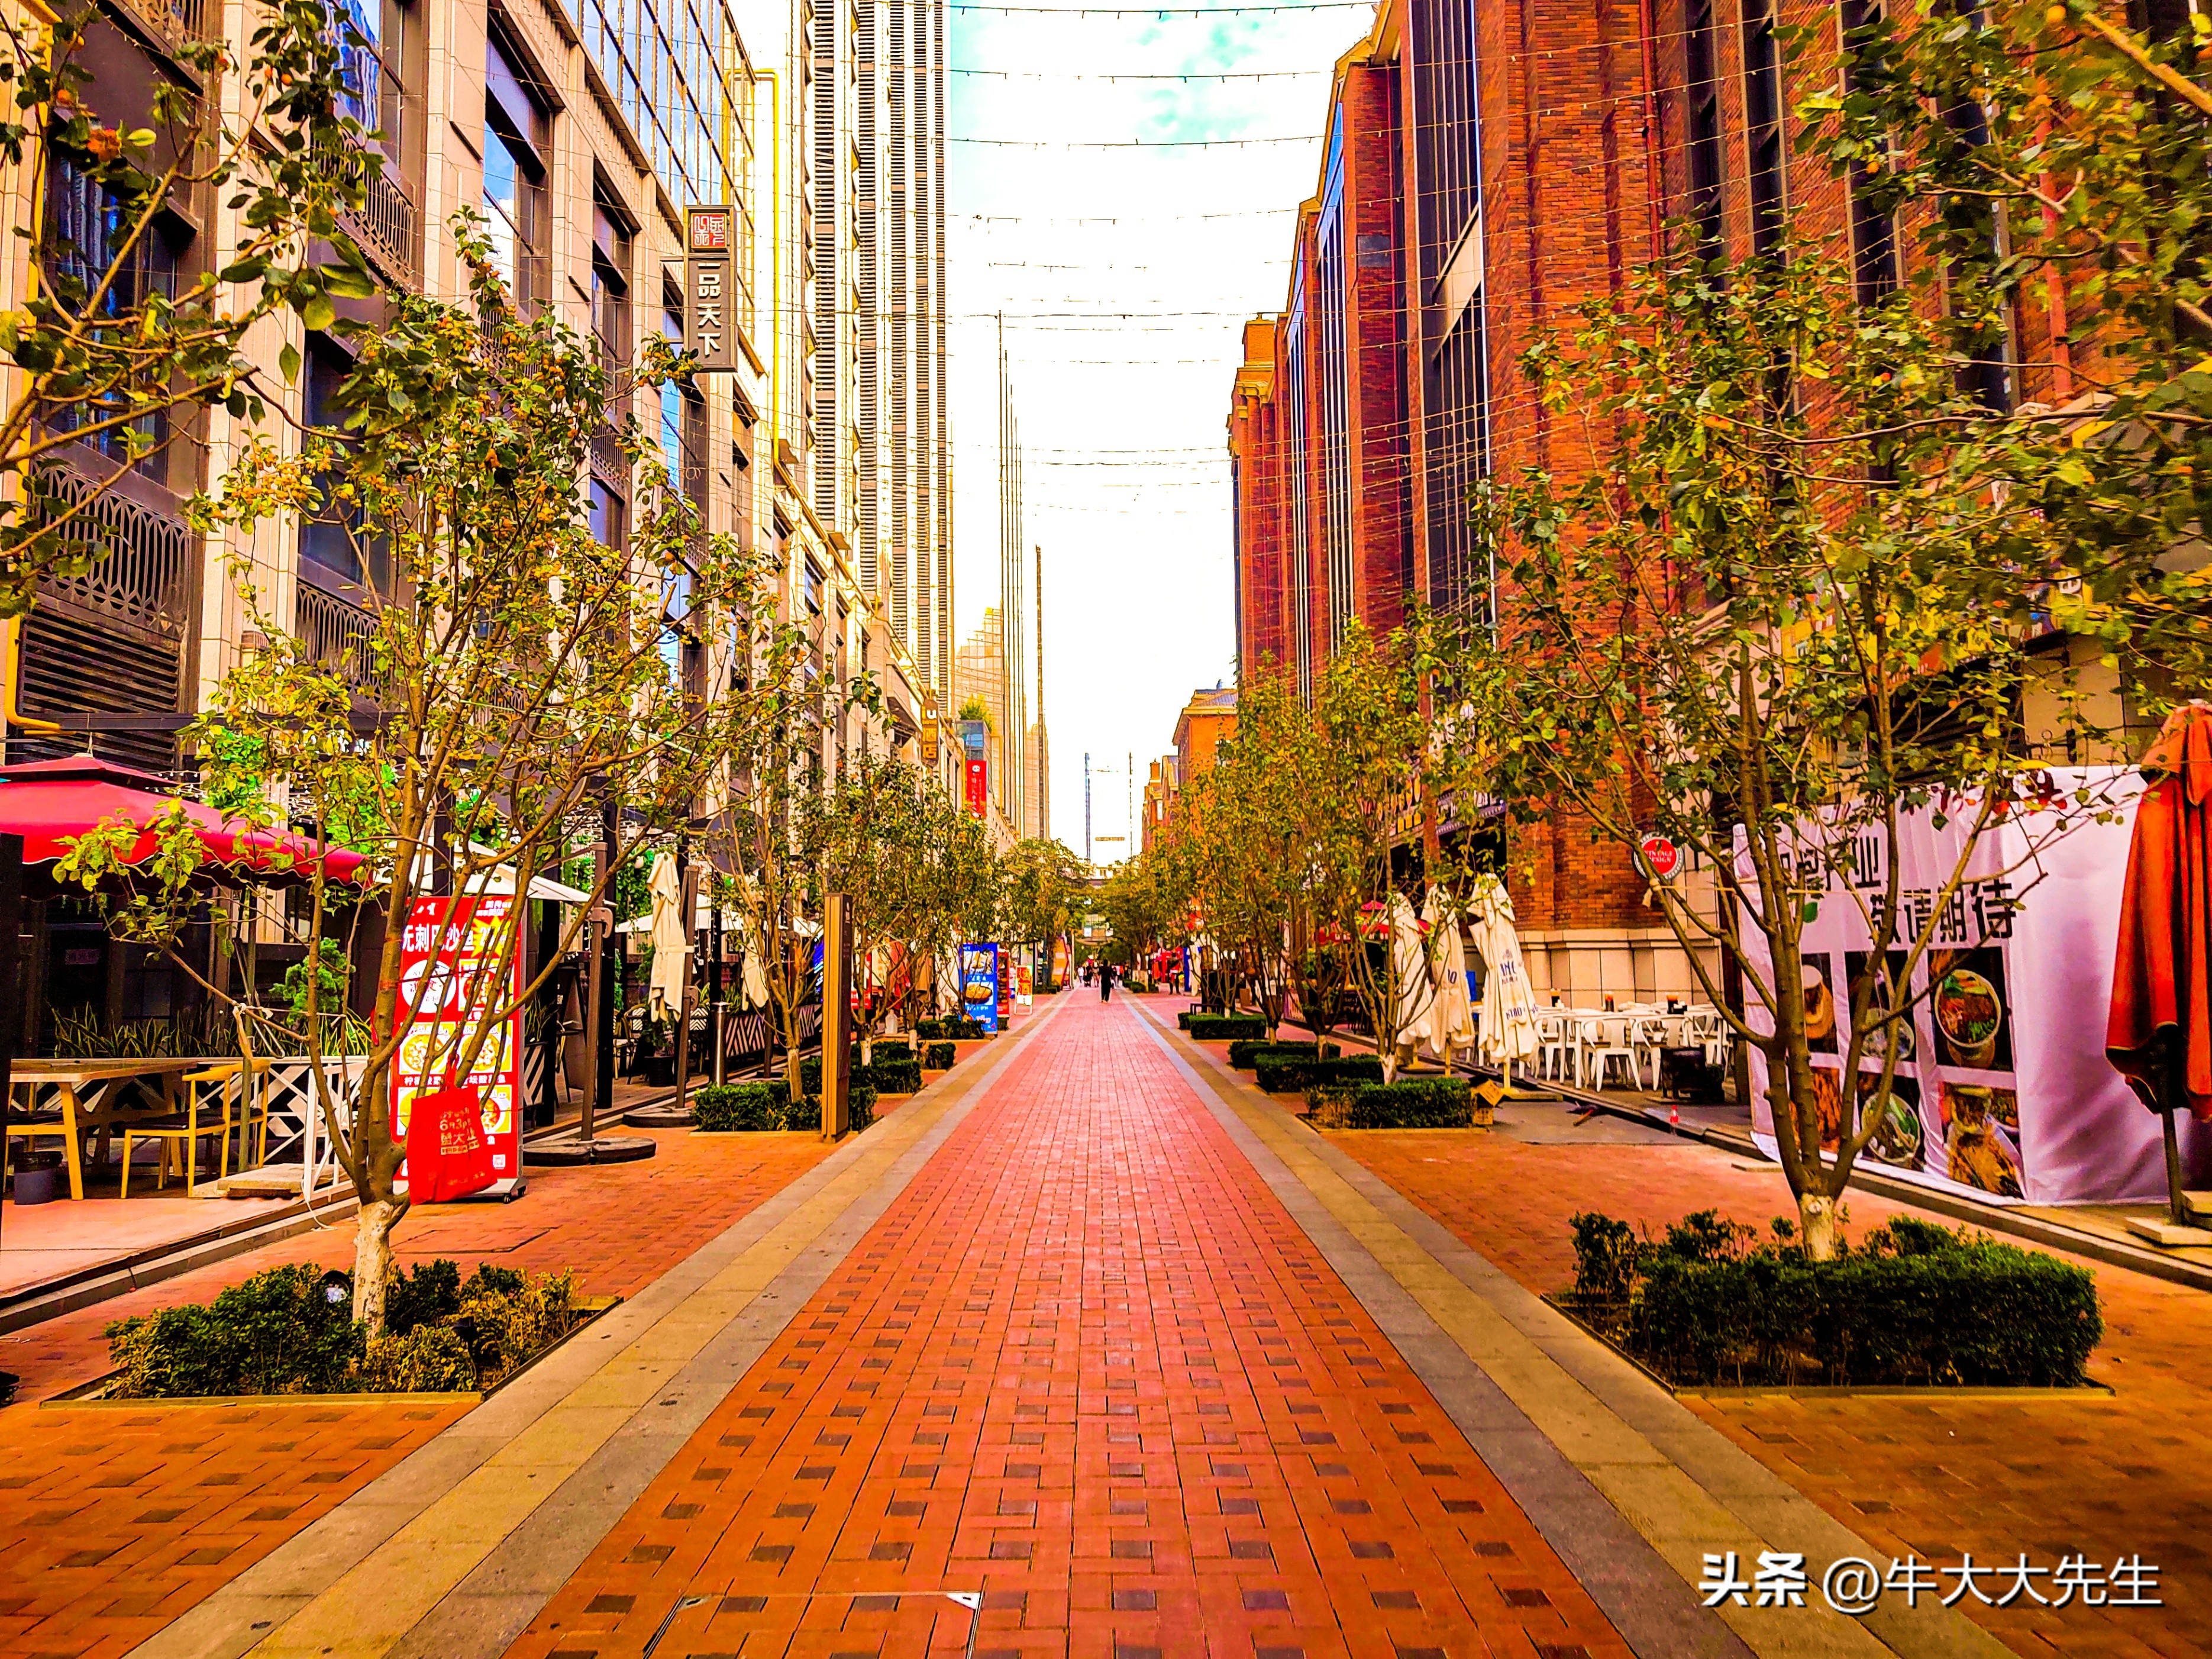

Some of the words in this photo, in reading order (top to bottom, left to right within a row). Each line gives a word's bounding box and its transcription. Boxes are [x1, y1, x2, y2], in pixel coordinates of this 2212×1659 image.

[697, 262, 722, 357] 一品天下
[922, 727, 937, 759] 酒店
[1869, 879, 2017, 945] 敬请期待
